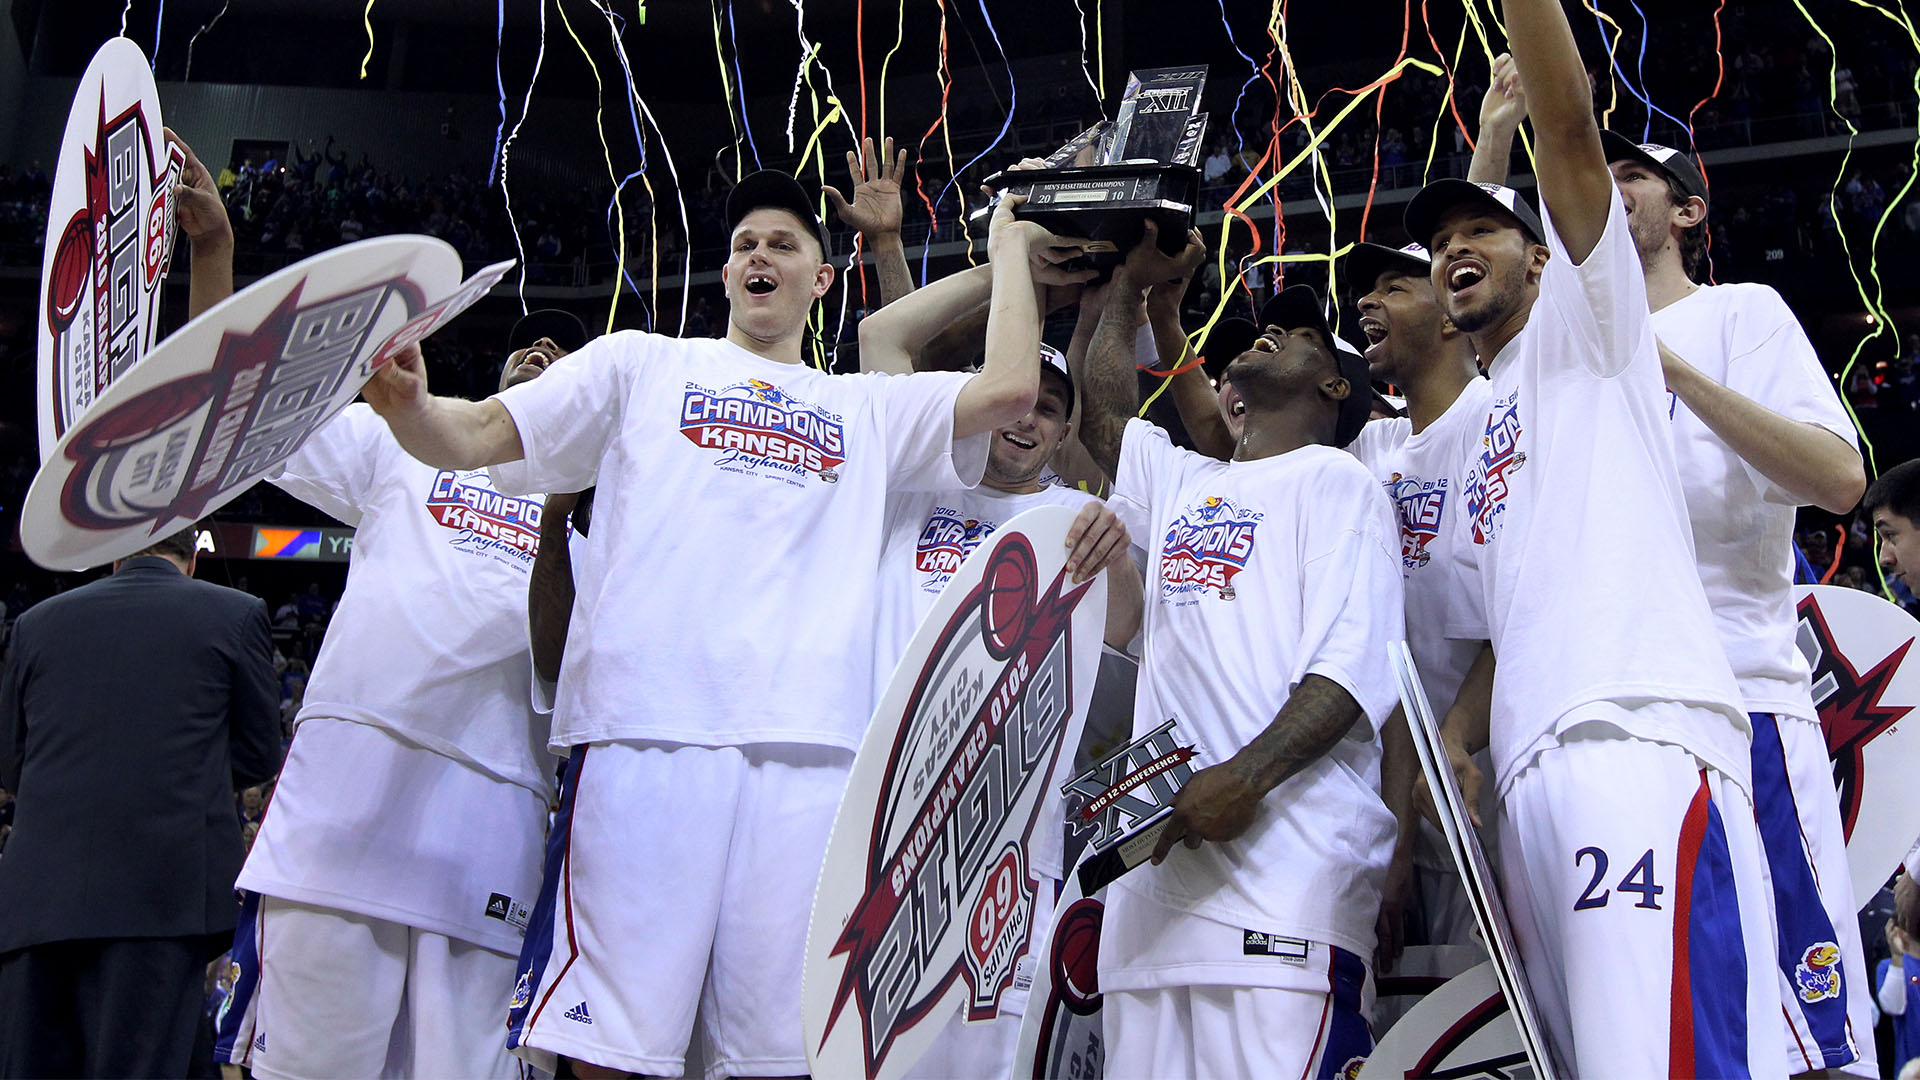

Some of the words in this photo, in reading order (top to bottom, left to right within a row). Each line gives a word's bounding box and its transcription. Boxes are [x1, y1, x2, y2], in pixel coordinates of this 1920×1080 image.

[1037, 194, 1051, 204] 20
[1060, 182, 1091, 190] BASKETBALL
[1091, 180, 1126, 189] CHAMPIONS
[1112, 191, 1125, 200] 10
[95, 213, 108, 287] 2010
[148, 206, 164, 268] 66
[81, 309, 92, 408] KANSA
[96, 295, 109, 388] CHAMP
[74, 346, 84, 408] CITY
[685, 381, 717, 396] 2010
[817, 406, 831, 420] BIG
[832, 414, 844, 423] 12
[684, 394, 842, 453] CHAMPIONS
[701, 427, 823, 472] KANSAS
[433, 471, 543, 528] CHAMPIO
[719, 466, 744, 475] KANSAS
[765, 474, 785, 483] SPRINT
[786, 479, 806, 489] CENTER
[1438, 478, 1448, 487] 12
[1254, 512, 1265, 521] 12
[920, 551, 961, 570] KAN
[929, 667, 969, 738] CITY
[991, 653, 1030, 726] 2010
[912, 668, 985, 800] KANSAS
[890, 720, 988, 897] CHAMPIONS
[1090, 796, 1107, 813] BIG
[1107, 788, 1119, 801] 12
[1119, 752, 1182, 793] CONFERENCE
[980, 866, 1012, 951] 66
[1573, 846, 1664, 911] 24
[983, 903, 1024, 987] PHILLIPS
[563, 1011, 593, 1025] adidas
